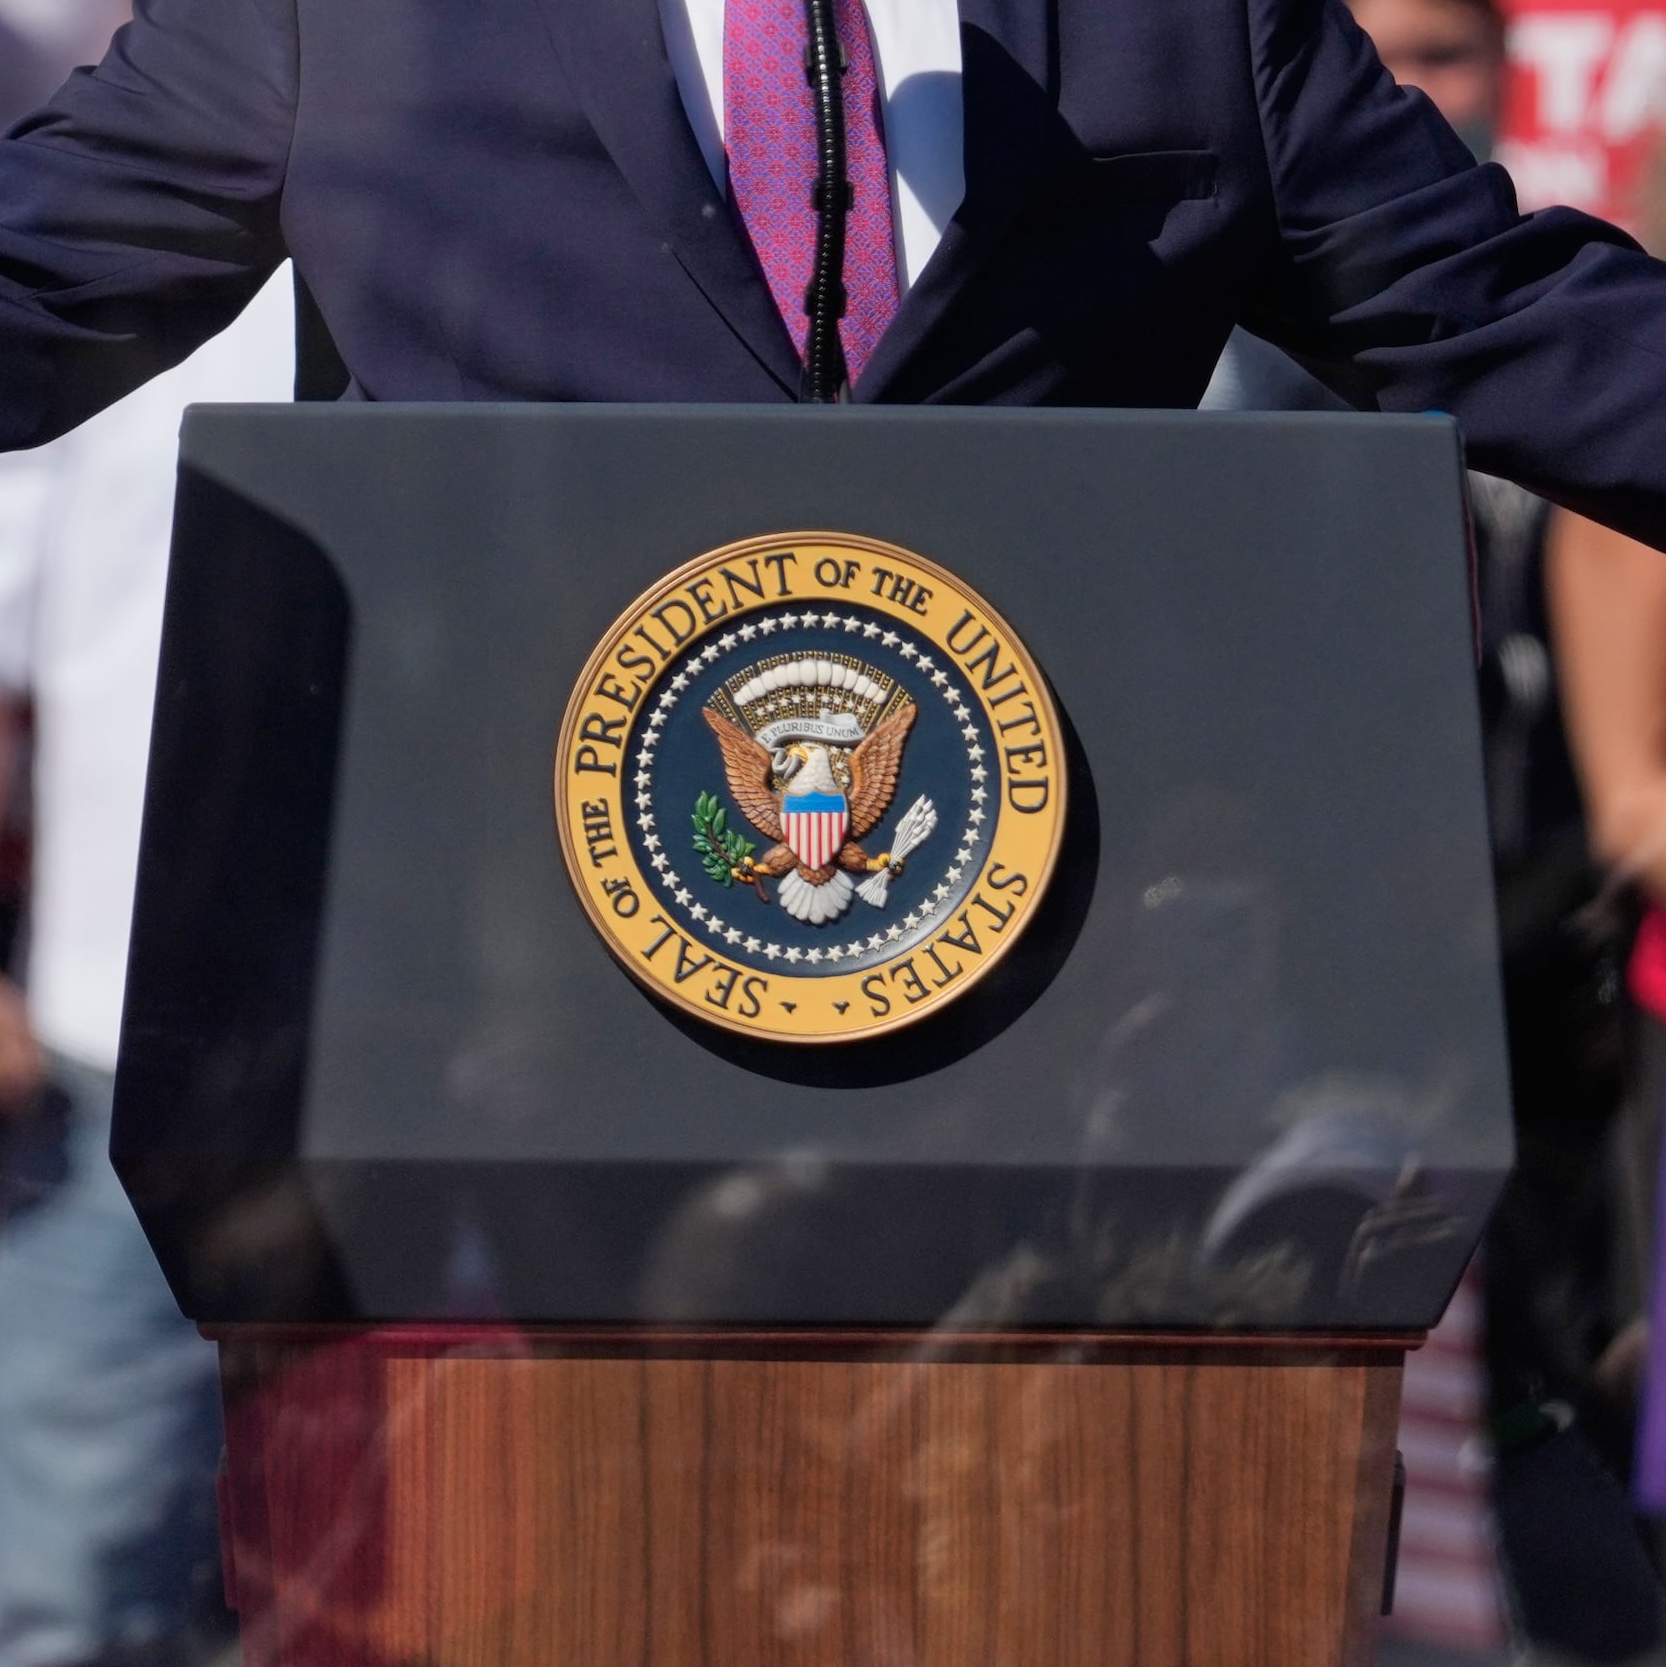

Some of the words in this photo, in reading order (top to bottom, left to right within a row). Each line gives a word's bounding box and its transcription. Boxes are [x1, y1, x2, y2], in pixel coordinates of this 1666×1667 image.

[814, 557, 861, 588] OF
[871, 566, 934, 617] THE
[575, 552, 798, 777] PRESIDENT
[772, 721, 824, 737] PLURIBUS
[825, 726, 860, 738] UNUM
[945, 609, 1049, 814] UNITED
[581, 798, 618, 868] THE
[600, 876, 640, 918] OF
[641, 914, 768, 1018] SEAL
[860, 862, 1028, 1018] STATES
